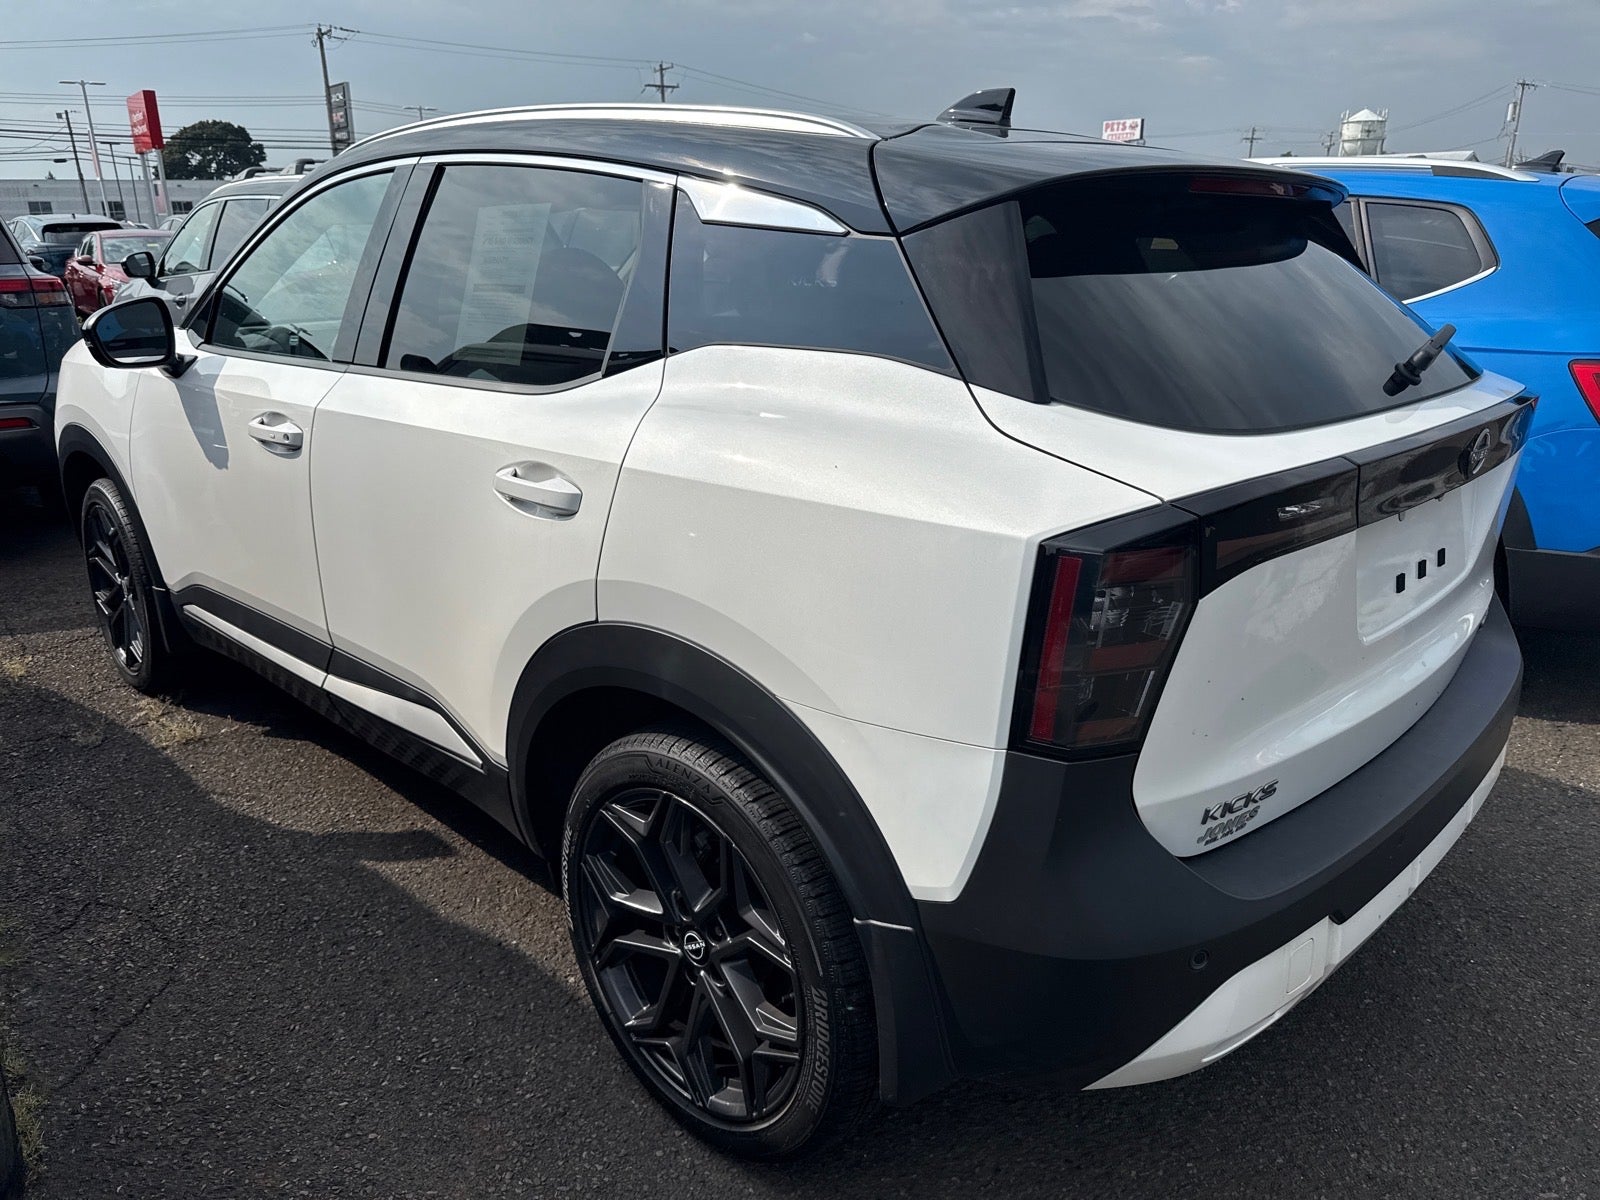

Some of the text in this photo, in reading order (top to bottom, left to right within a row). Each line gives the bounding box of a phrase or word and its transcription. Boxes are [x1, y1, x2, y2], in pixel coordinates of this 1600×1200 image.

[1105, 121, 1127, 132] PETS
[655, 758, 711, 793] ALENZA
[1200, 779, 1279, 825] KICKS
[806, 984, 830, 1114] BRIDGESTONE
